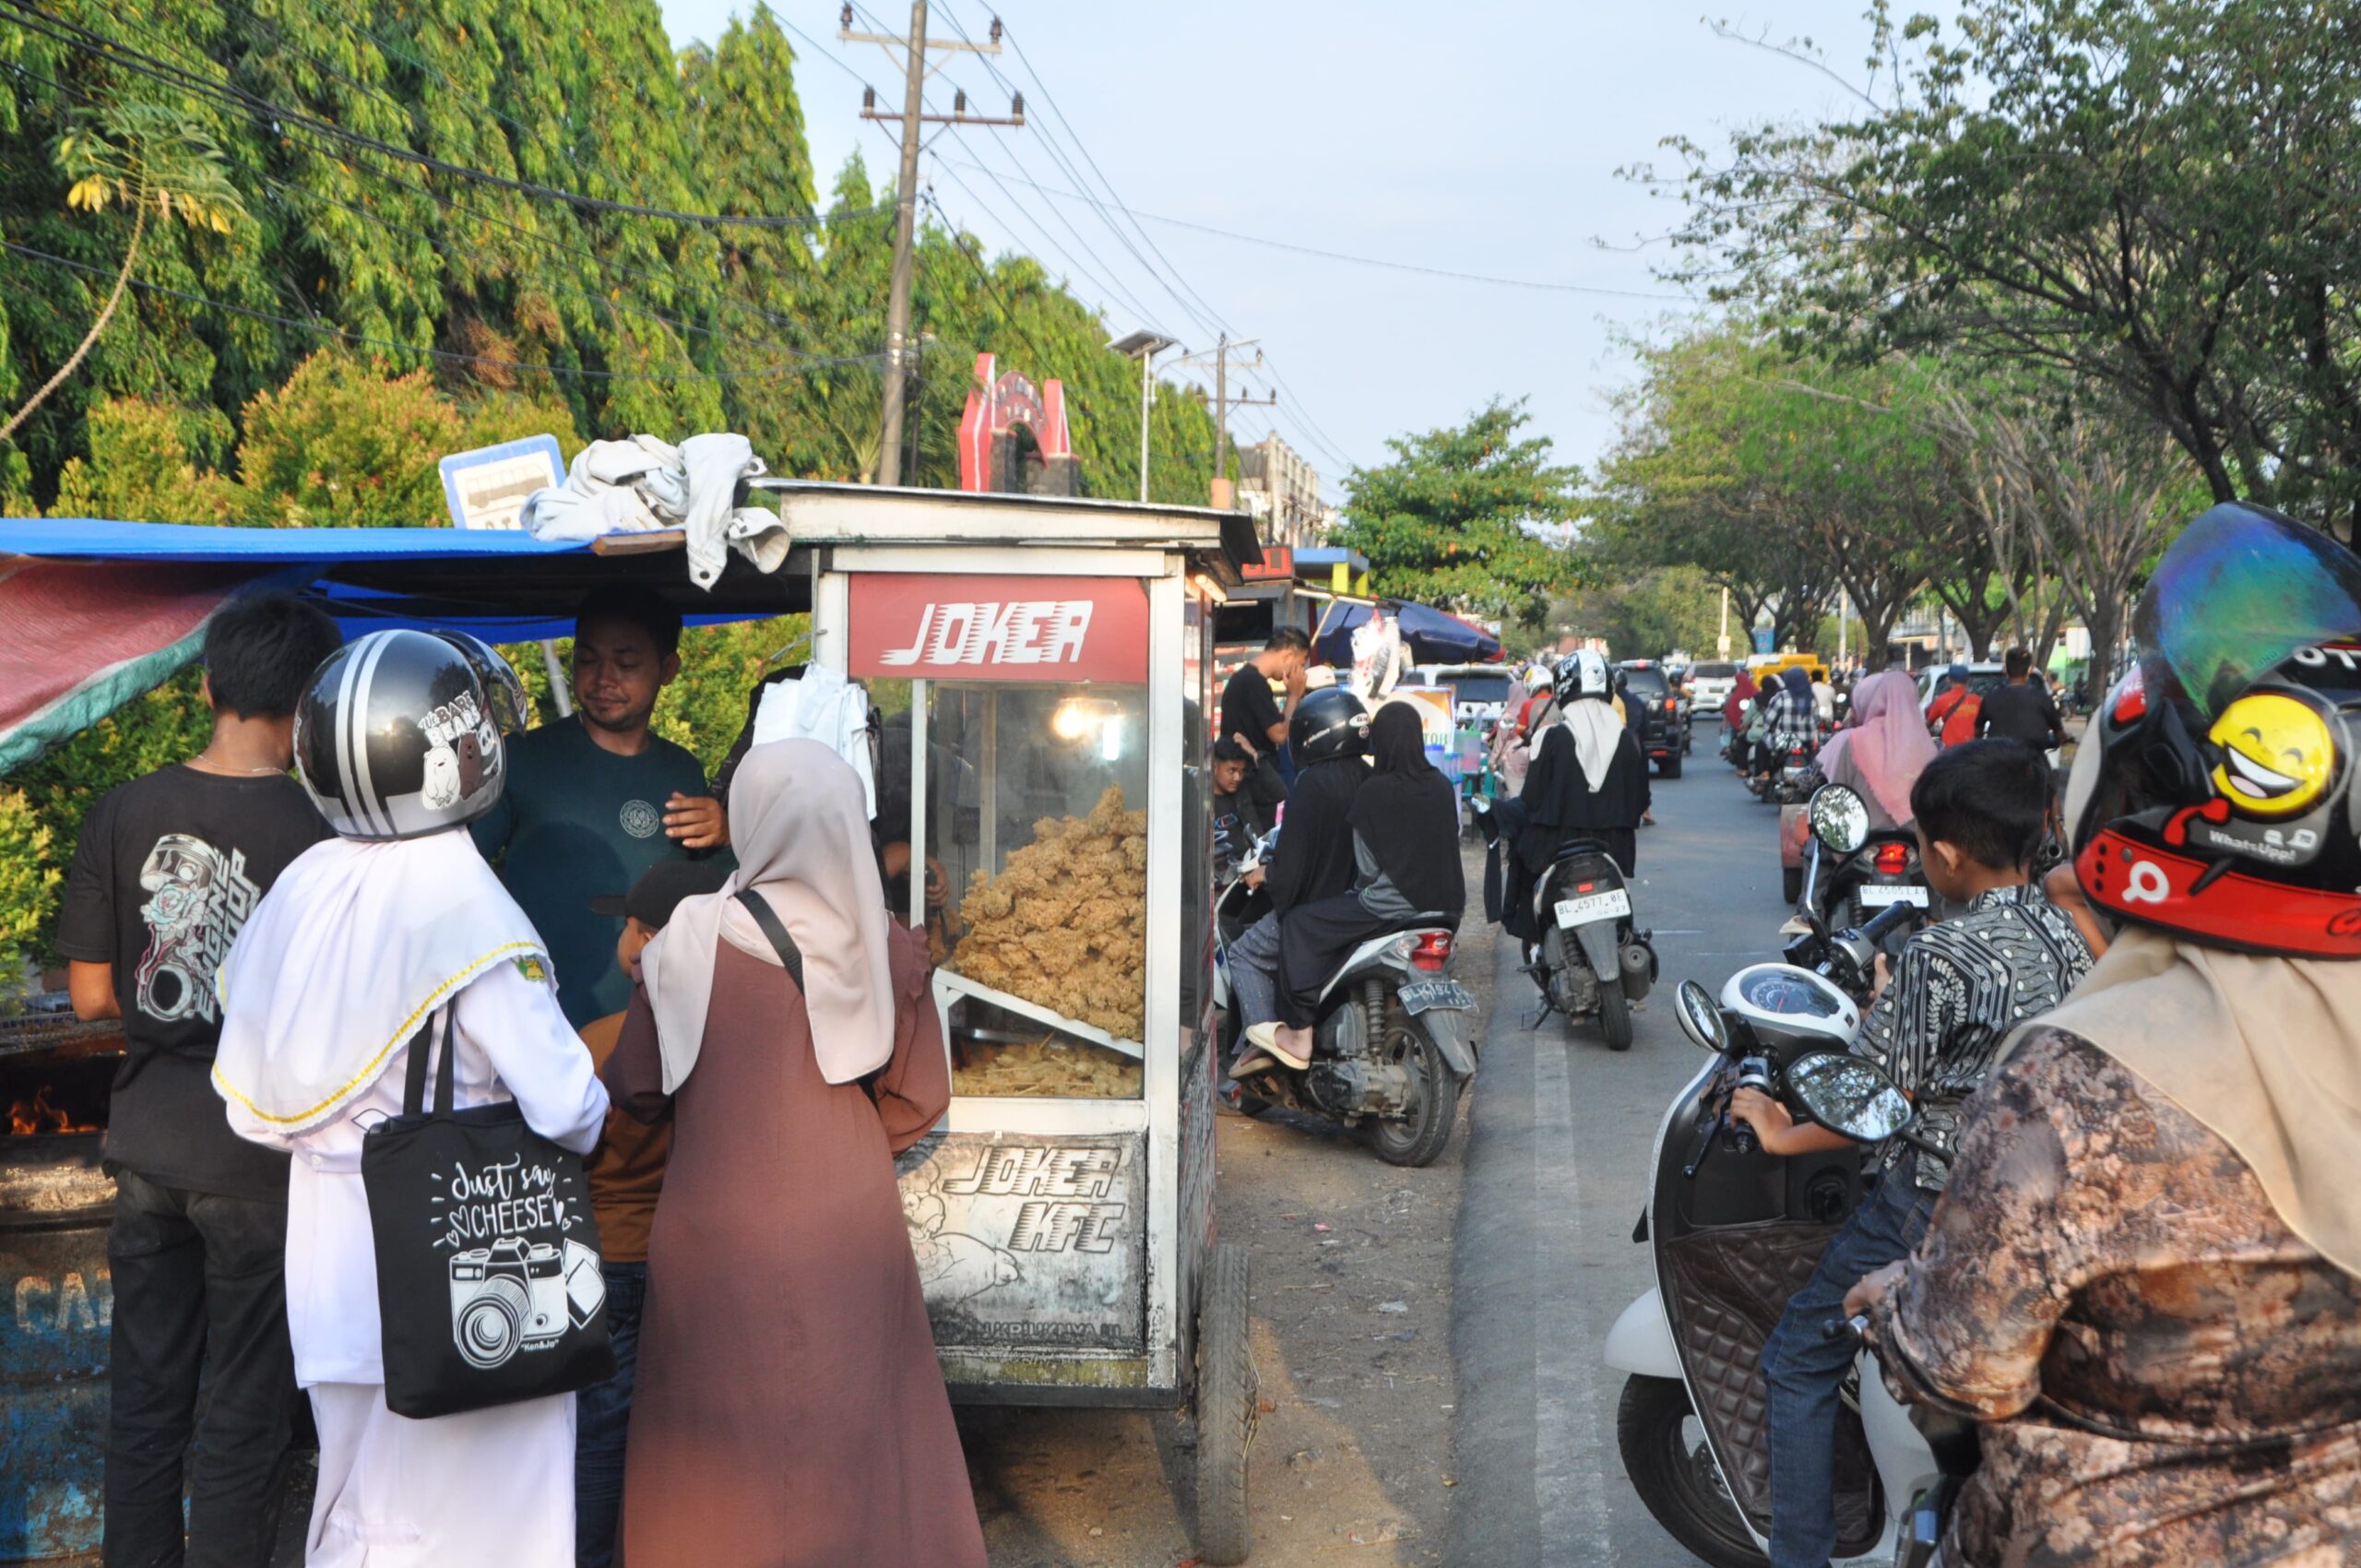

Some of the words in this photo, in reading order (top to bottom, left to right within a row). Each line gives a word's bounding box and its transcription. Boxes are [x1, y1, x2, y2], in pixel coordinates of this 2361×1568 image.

[879, 600, 1094, 666] JOKER
[425, 704, 481, 748] BEARS
[434, 690, 476, 724] BARE
[2210, 830, 2297, 862] WhatsUpp!
[1558, 904, 1571, 915] BL
[1578, 897, 1602, 909] 4577
[194, 847, 231, 1024] ENGINE
[452, 1152, 520, 1200] Just
[521, 1165, 556, 1198] say
[942, 1146, 1122, 1197] JOKER
[471, 1194, 552, 1238] CHEESE
[1007, 1202, 1126, 1253] KFC
